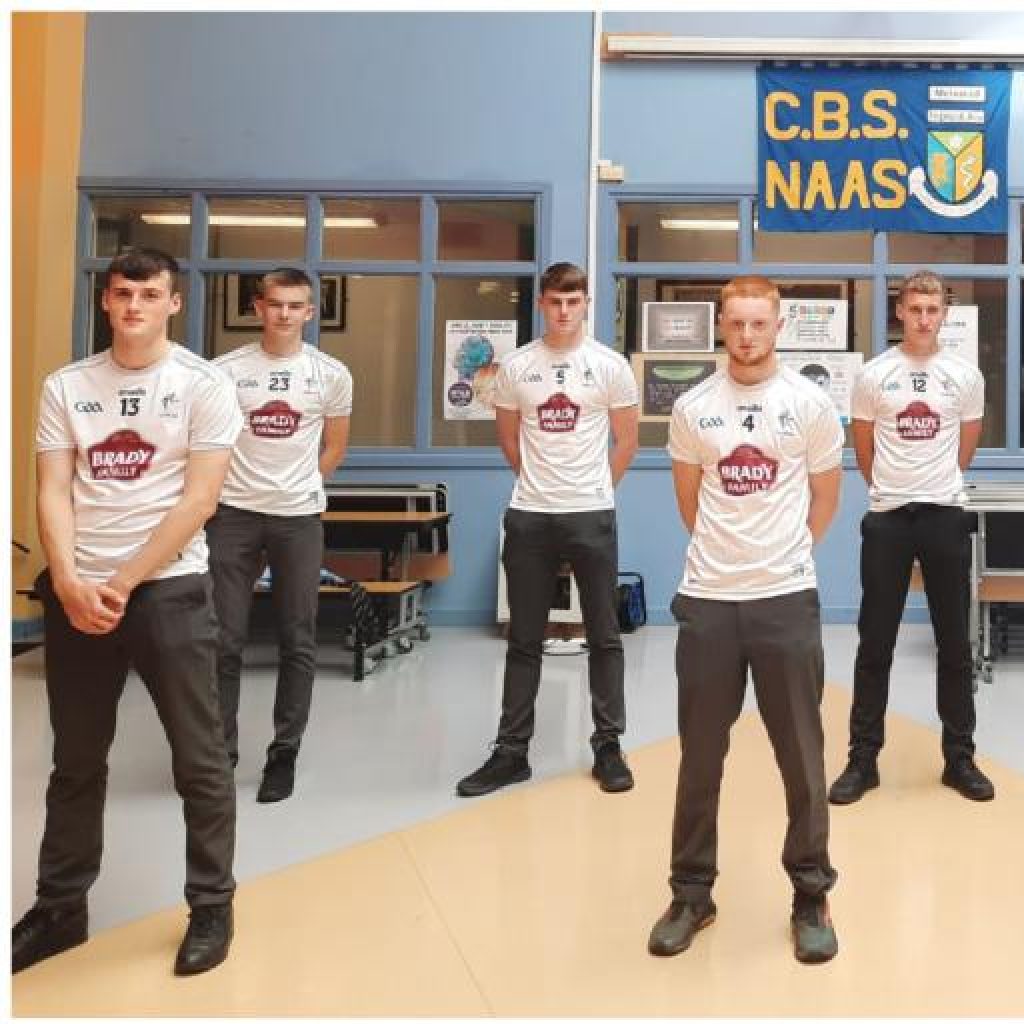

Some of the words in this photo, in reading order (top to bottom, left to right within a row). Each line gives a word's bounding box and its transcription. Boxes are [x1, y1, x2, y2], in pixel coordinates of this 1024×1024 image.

[764, 89, 909, 141] C.B.S.
[765, 159, 908, 212] NAAS
[269, 377, 289, 392] 23
[912, 377, 928, 393] 12
[120, 397, 141, 417] 13
[741, 413, 755, 432] 4
[92, 449, 150, 467] BRADY
[721, 463, 773, 481] BRADY
